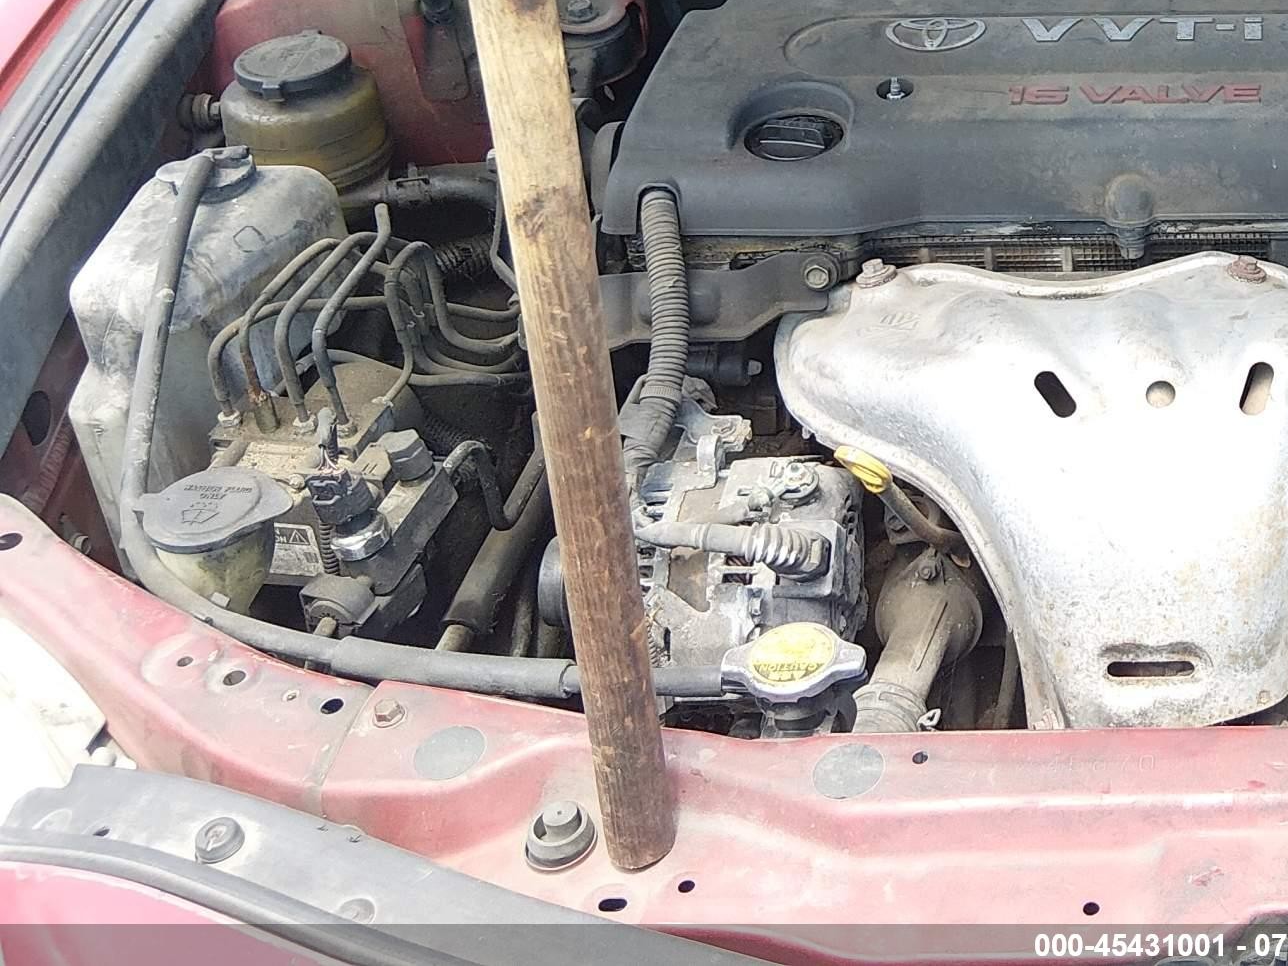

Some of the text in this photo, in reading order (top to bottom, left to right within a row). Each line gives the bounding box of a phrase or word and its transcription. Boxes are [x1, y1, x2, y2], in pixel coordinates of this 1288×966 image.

[1022, 17, 1264, 42] VVT-i
[1009, 83, 1263, 106] 16 VALVE
